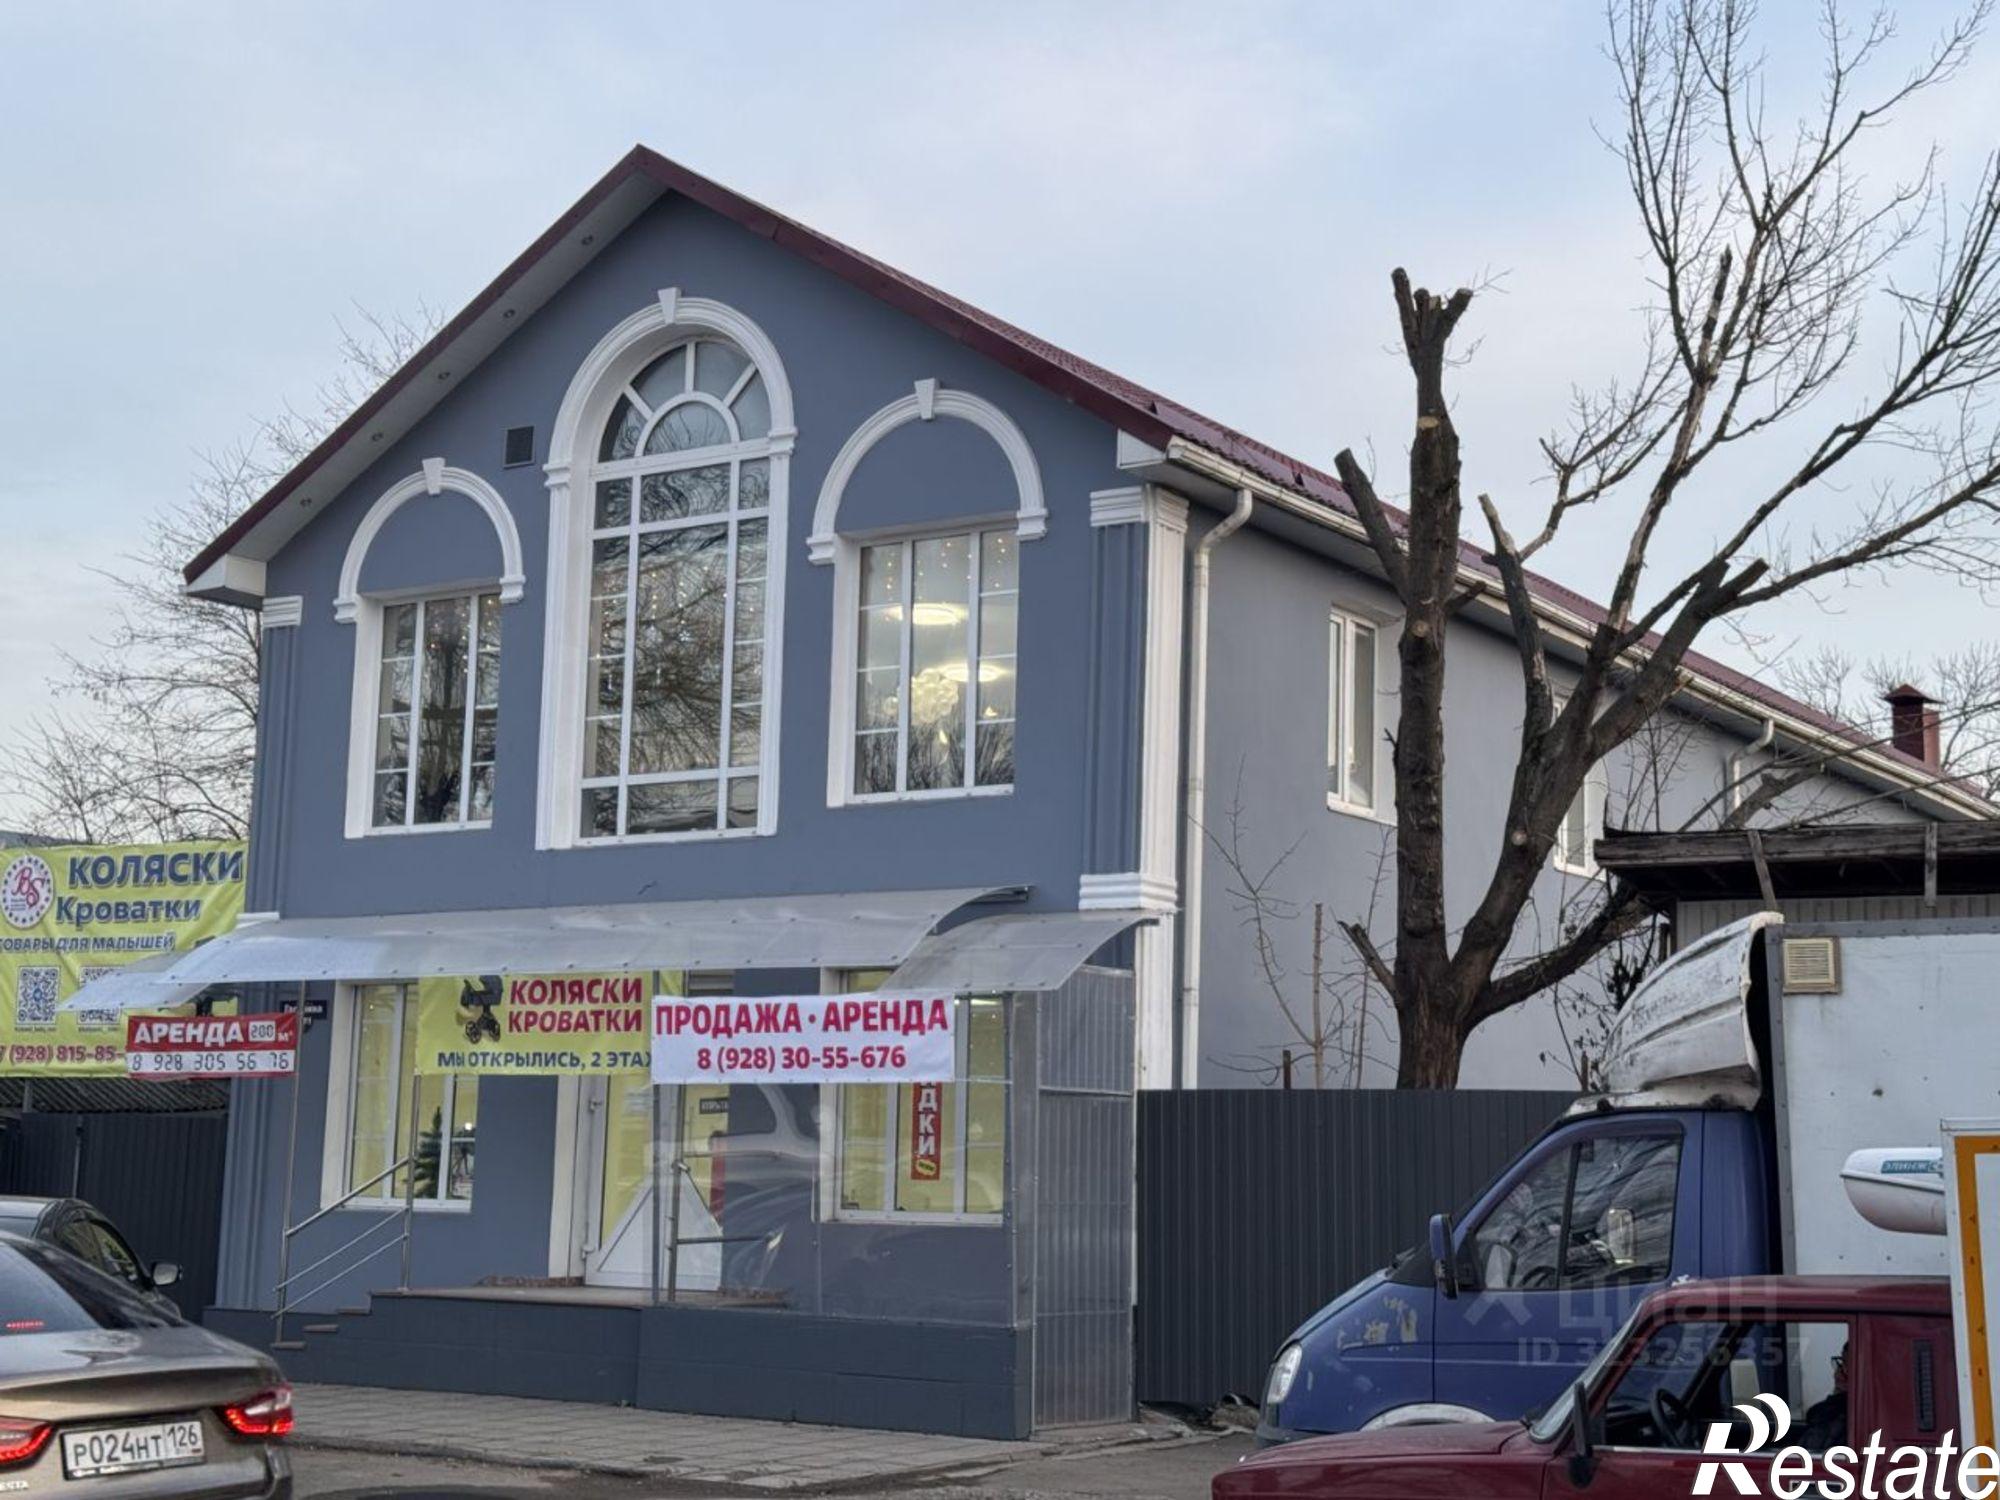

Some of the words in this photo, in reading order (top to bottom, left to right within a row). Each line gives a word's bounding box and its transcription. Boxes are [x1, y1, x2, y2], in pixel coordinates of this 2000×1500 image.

[68, 851, 244, 888] КОЛЯСКИ
[55, 896, 202, 931] Кроватки
[55, 936, 90, 951] ДЛЯ
[92, 932, 176, 950] МАЛЫШЕЙ
[509, 978, 643, 1005] КОЛЯСКИ
[507, 1009, 643, 1033] КРОВАТКИ
[655, 1003, 803, 1038] ПРОДАЖА
[822, 998, 948, 1036] АРЕНДА
[134, 1020, 245, 1047] АРЕНДА
[9, 1043, 54, 1065] (928)
[132, 1055, 142, 1071] 8
[154, 1055, 183, 1071] 928
[269, 1052, 289, 1069] 76
[438, 1052, 464, 1067] МЫ
[468, 1052, 586, 1070] ОТКРЫЛИСЬ,
[591, 1052, 601, 1067] 2
[608, 1051, 652, 1068] ЭТА
[697, 1049, 711, 1070] 8
[717, 1049, 776, 1073] (928)
[782, 1045, 907, 1070] 30-55-676
[74, 1432, 162, 1466] Р024НТ
[168, 1425, 198, 1447] 126
